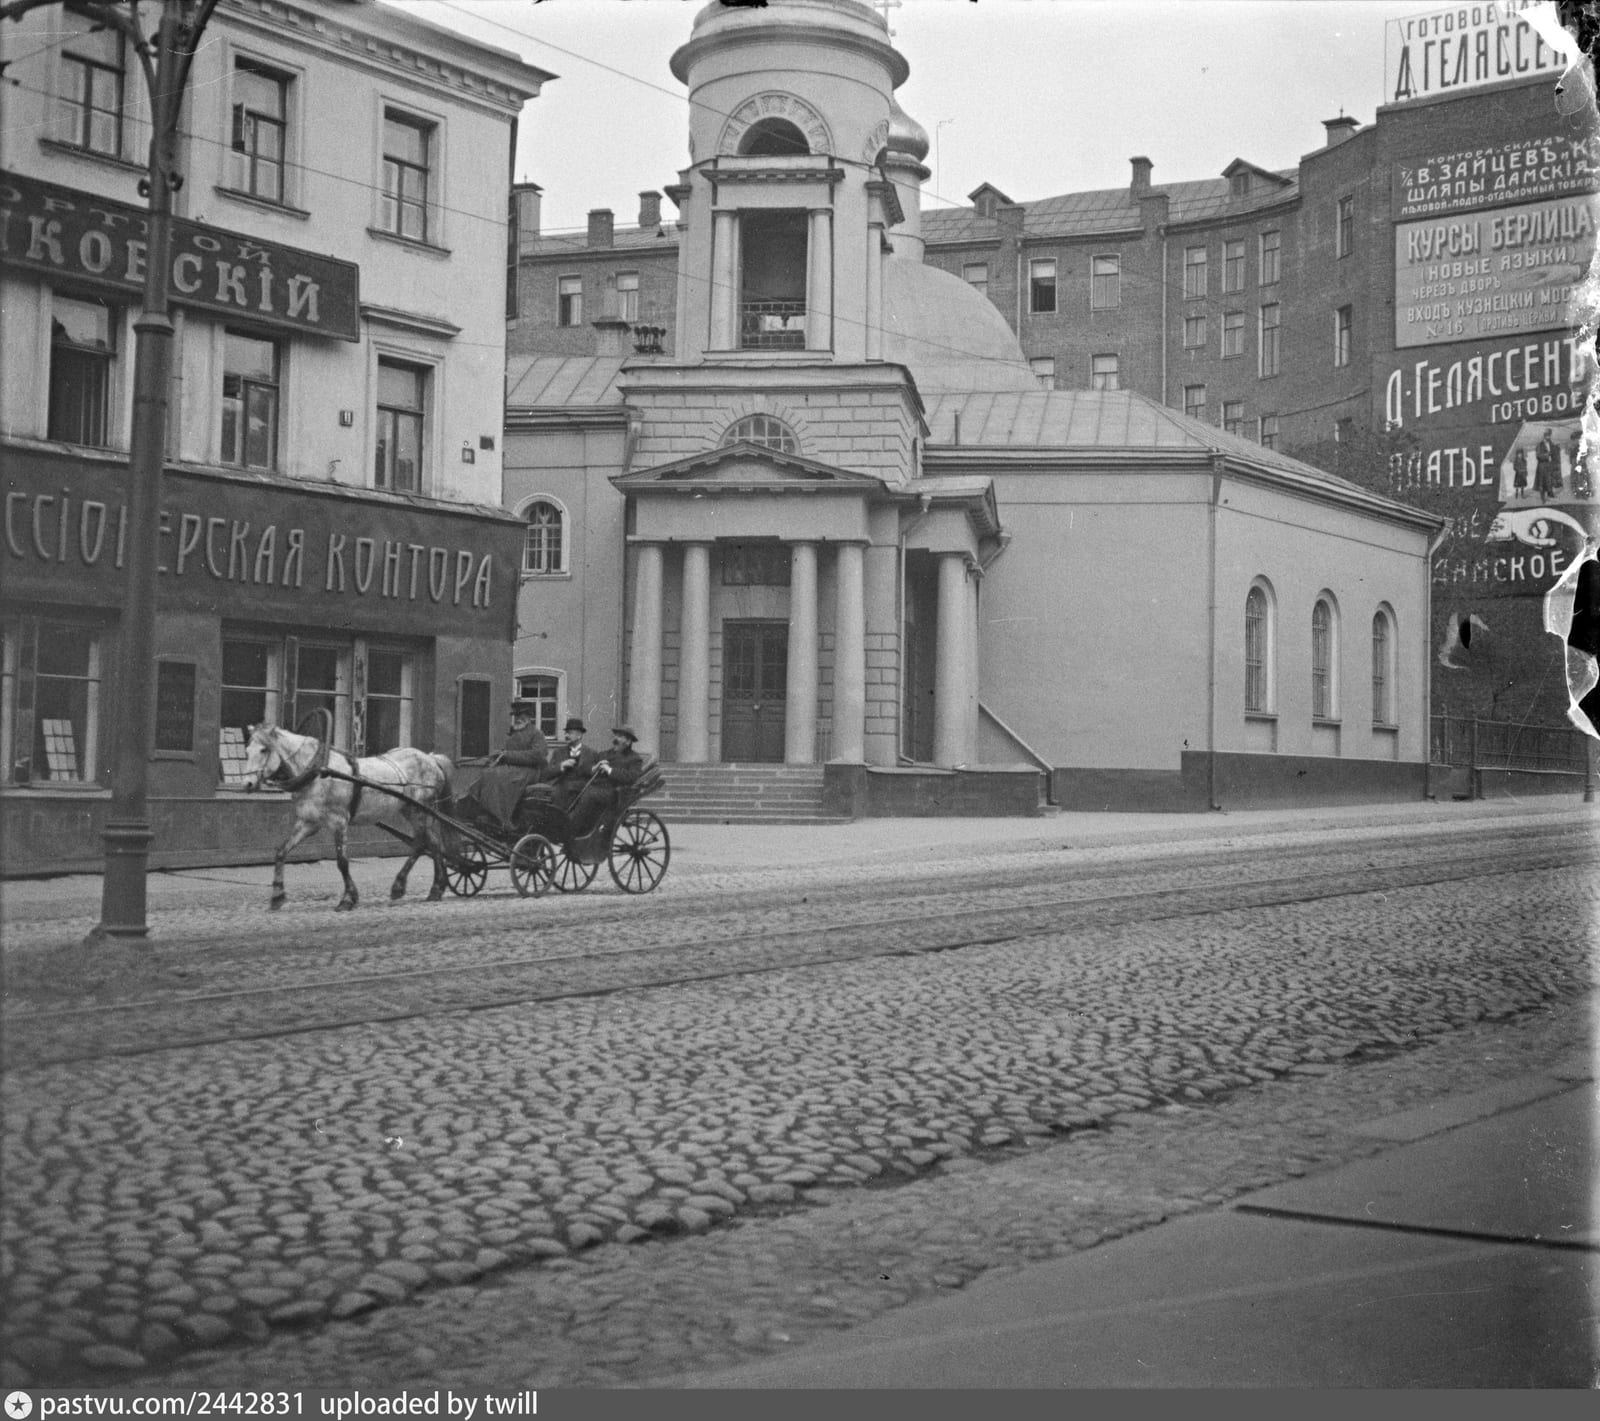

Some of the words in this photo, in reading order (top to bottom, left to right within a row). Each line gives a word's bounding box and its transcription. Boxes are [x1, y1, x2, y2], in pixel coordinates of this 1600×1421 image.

[1407, 3, 1495, 40] ГОТОВОЕ
[1424, 21, 1567, 91] ГЕЛЯССЕ
[1408, 177, 1485, 202] ШЛЯПЫ
[1494, 160, 1588, 190] ДАМСКІЯ
[1439, 147, 1557, 180] ЗАЙЦЕВЪ
[1407, 221, 1479, 262] КУРСЫ
[1491, 204, 1593, 250] БЕРЛИЦА
[1412, 285, 1456, 300] ЧЕРЕЗЪ
[1460, 276, 1501, 295] ДВОРЪ
[1407, 303, 1450, 323] ВХОДЪ
[1457, 290, 1534, 317] КУЗНЕЦКІЙ
[1448, 320, 1464, 336] 16
[1491, 391, 1583, 424] ГОТОВОЕ
[325, 533, 494, 608] КОНТОРА
